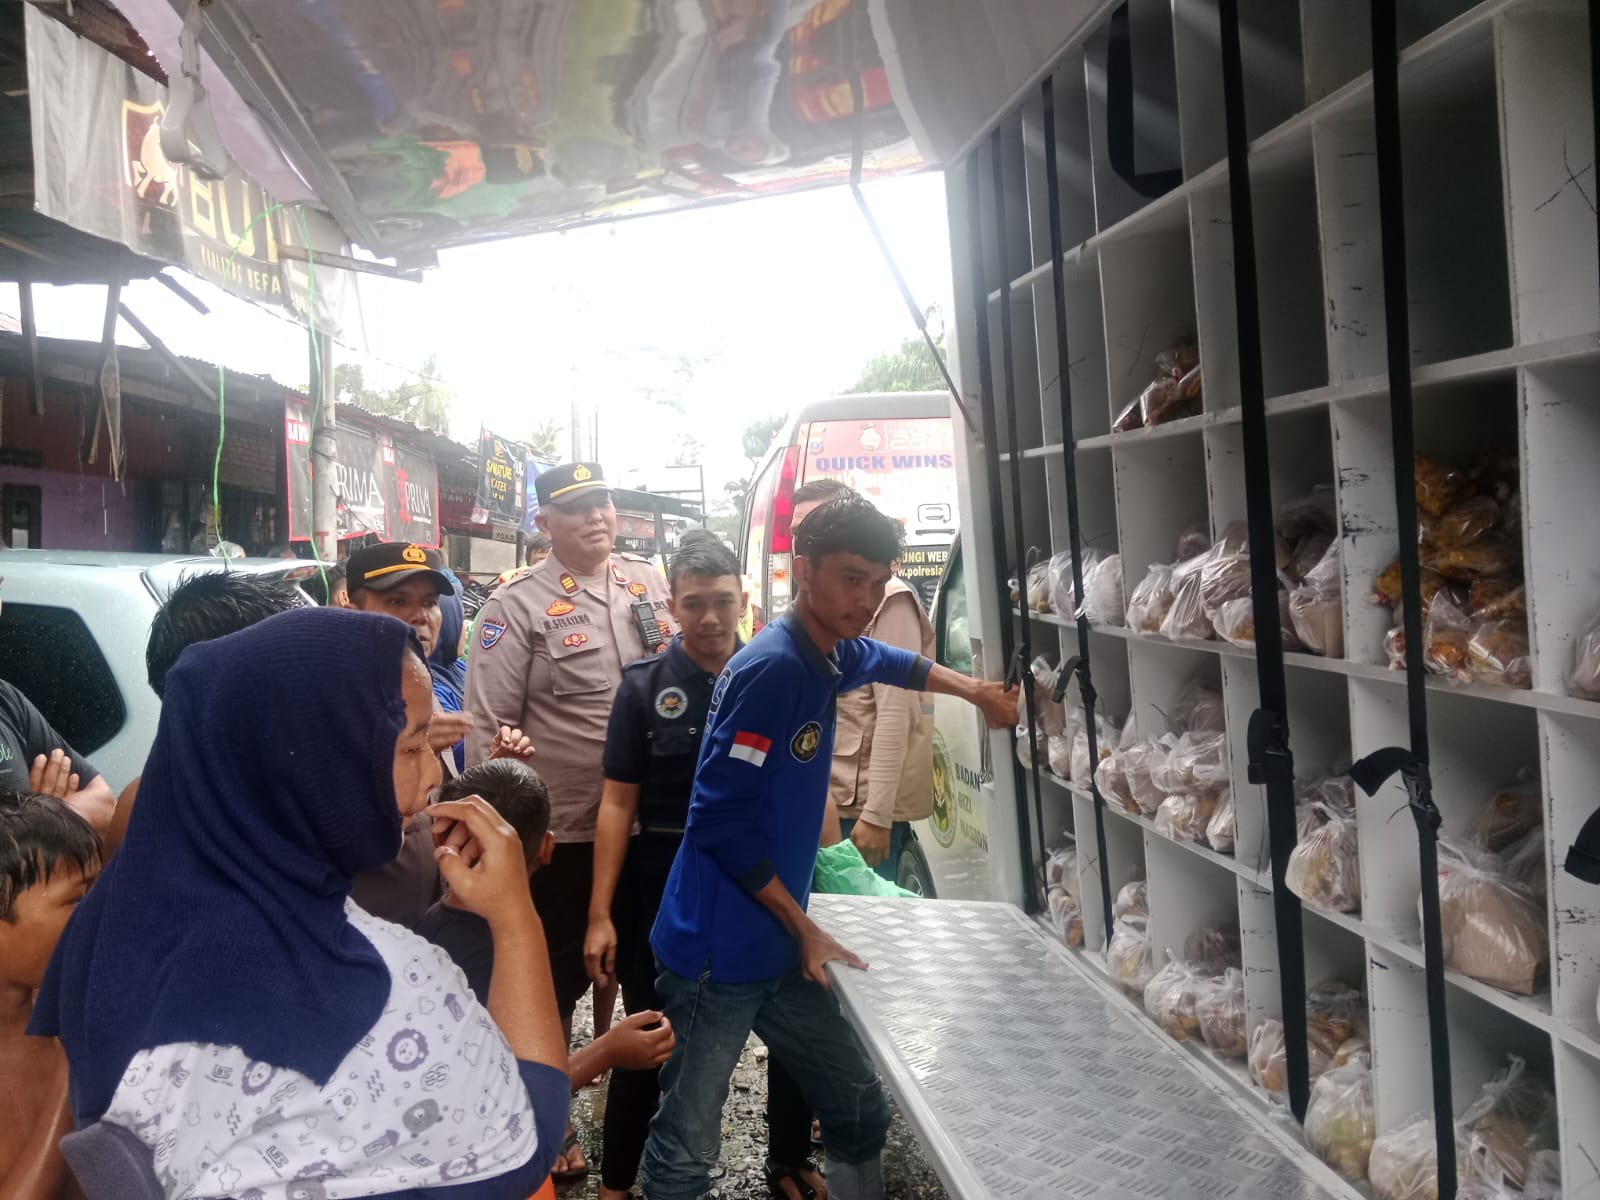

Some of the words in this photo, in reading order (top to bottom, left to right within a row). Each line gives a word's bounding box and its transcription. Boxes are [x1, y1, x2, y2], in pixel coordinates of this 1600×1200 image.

[815, 455, 887, 473] QUICK
[891, 453, 953, 471] WINS
[902, 551, 925, 563] UNGI
[927, 551, 948, 563] WEB
[897, 565, 944, 580] w.polresla
[955, 763, 981, 793] BADAN
